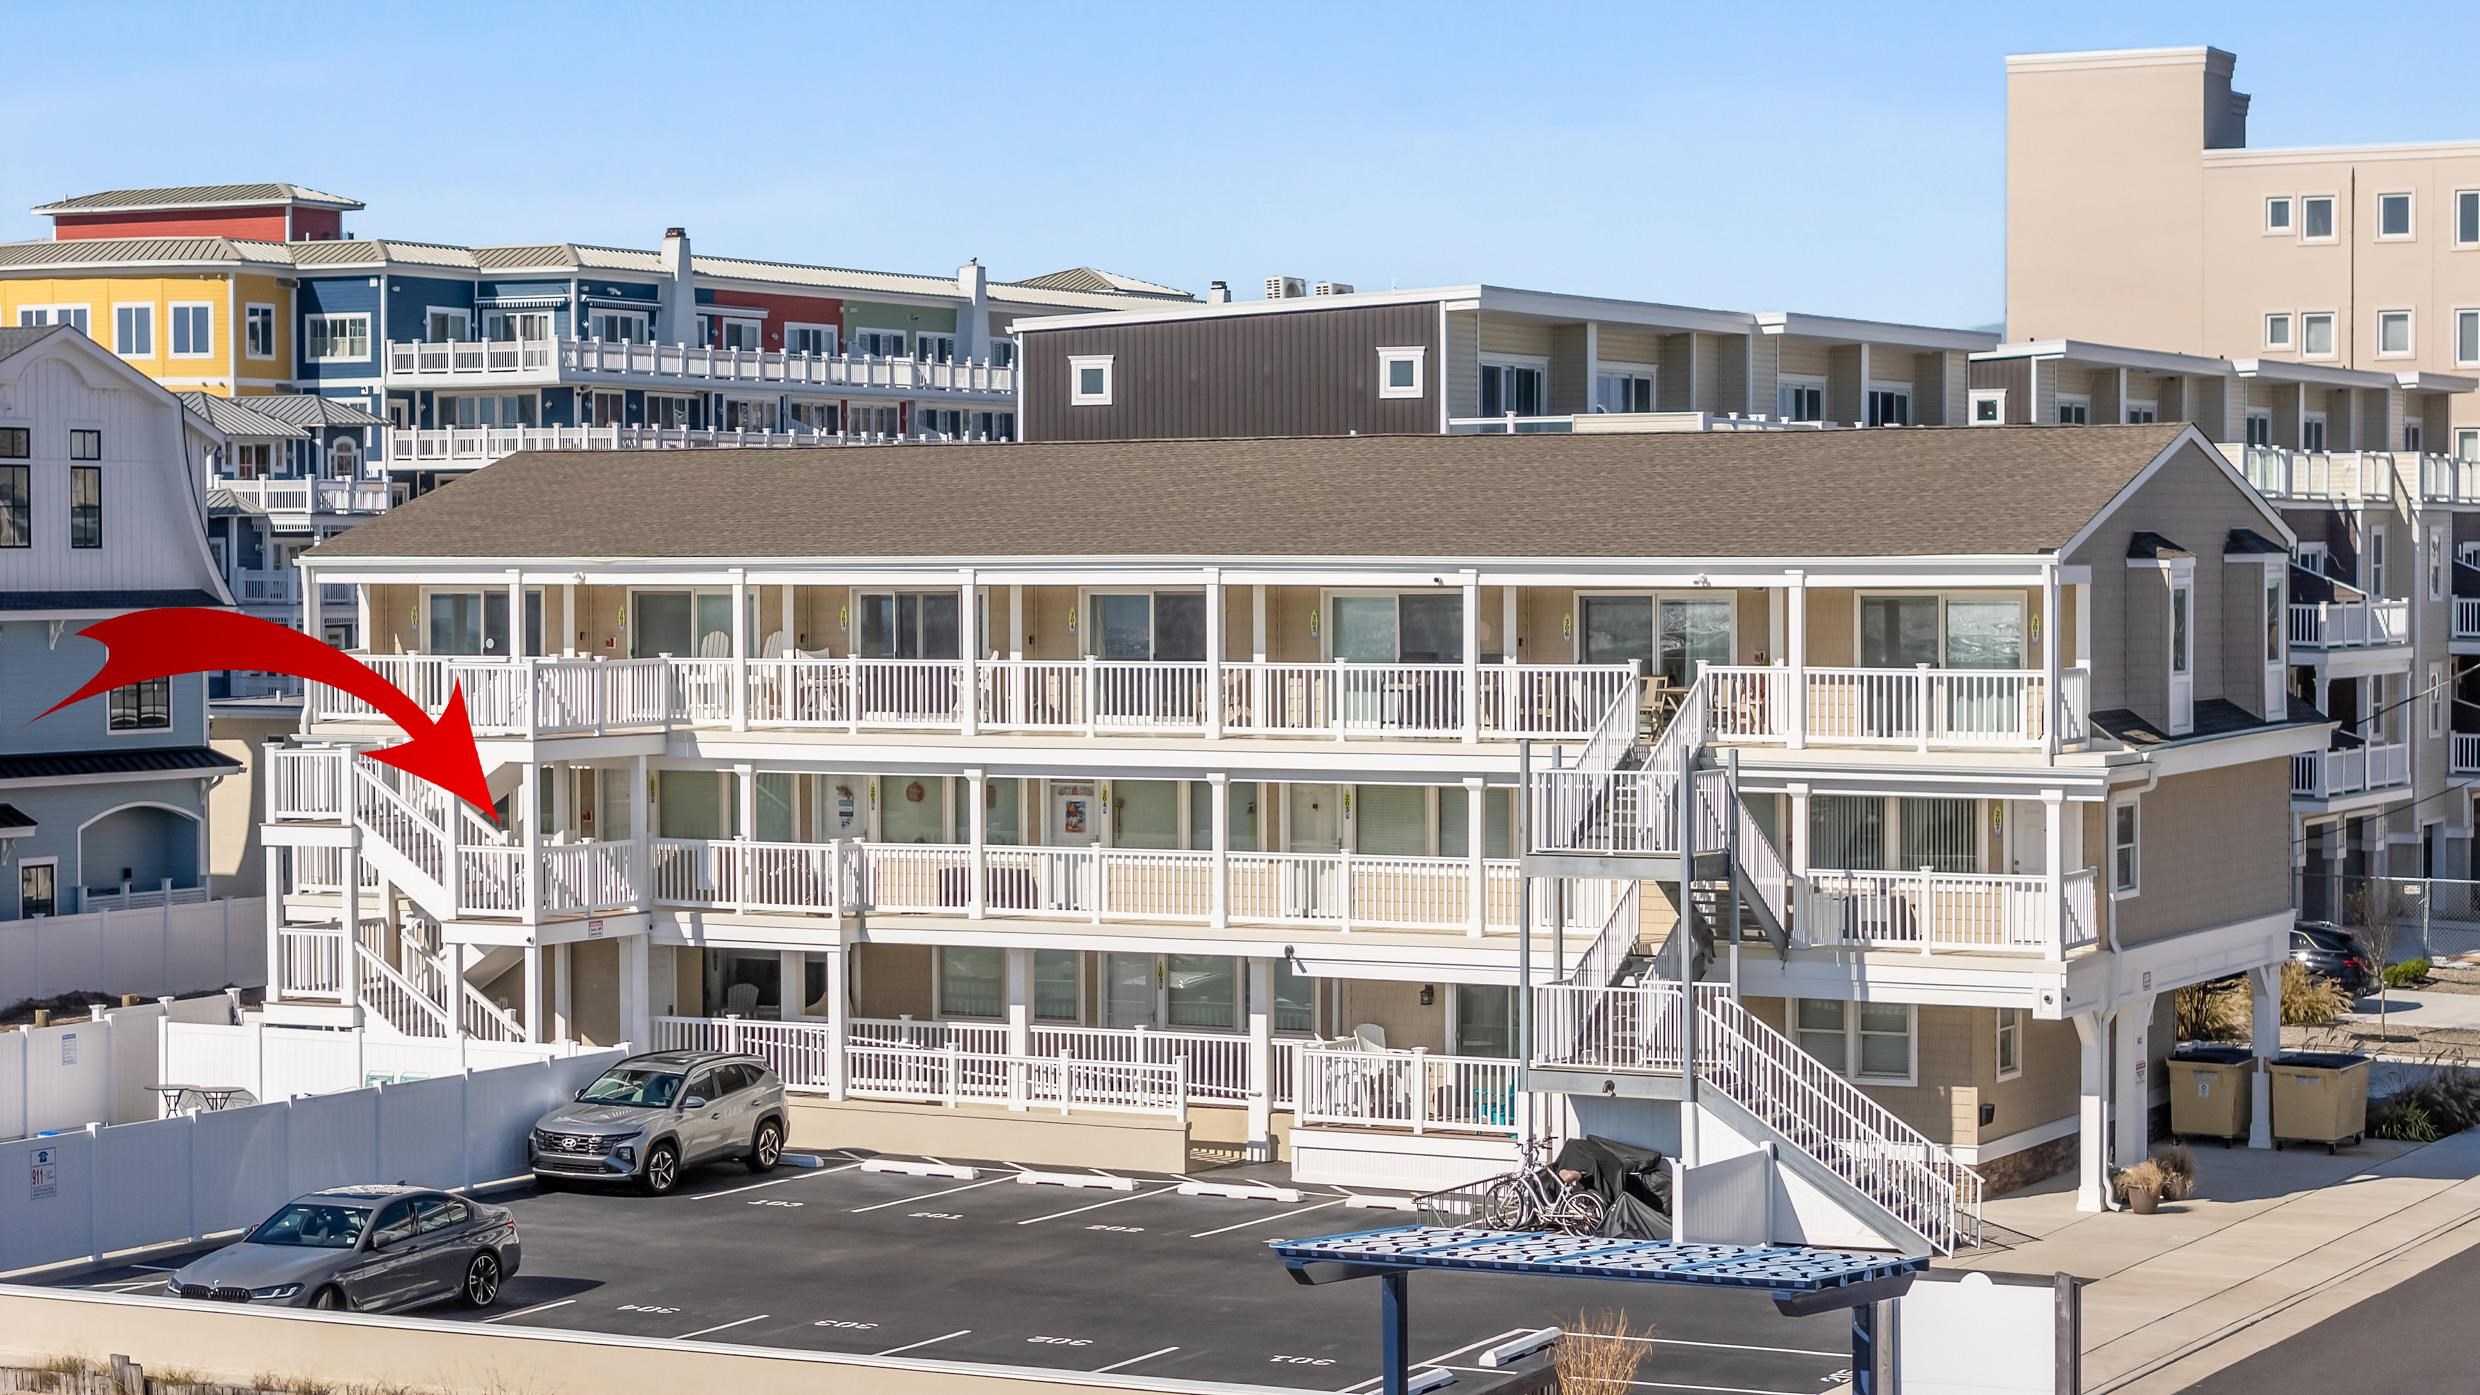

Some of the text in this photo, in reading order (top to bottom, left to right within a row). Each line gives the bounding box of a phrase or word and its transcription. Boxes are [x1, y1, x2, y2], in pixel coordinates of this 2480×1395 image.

[32, 1168, 44, 1185] 911
[616, 1304, 681, 1314] 304
[813, 1319, 879, 1330] 303
[1026, 1335, 1094, 1346] 302
[1269, 1354, 1337, 1366] 301
